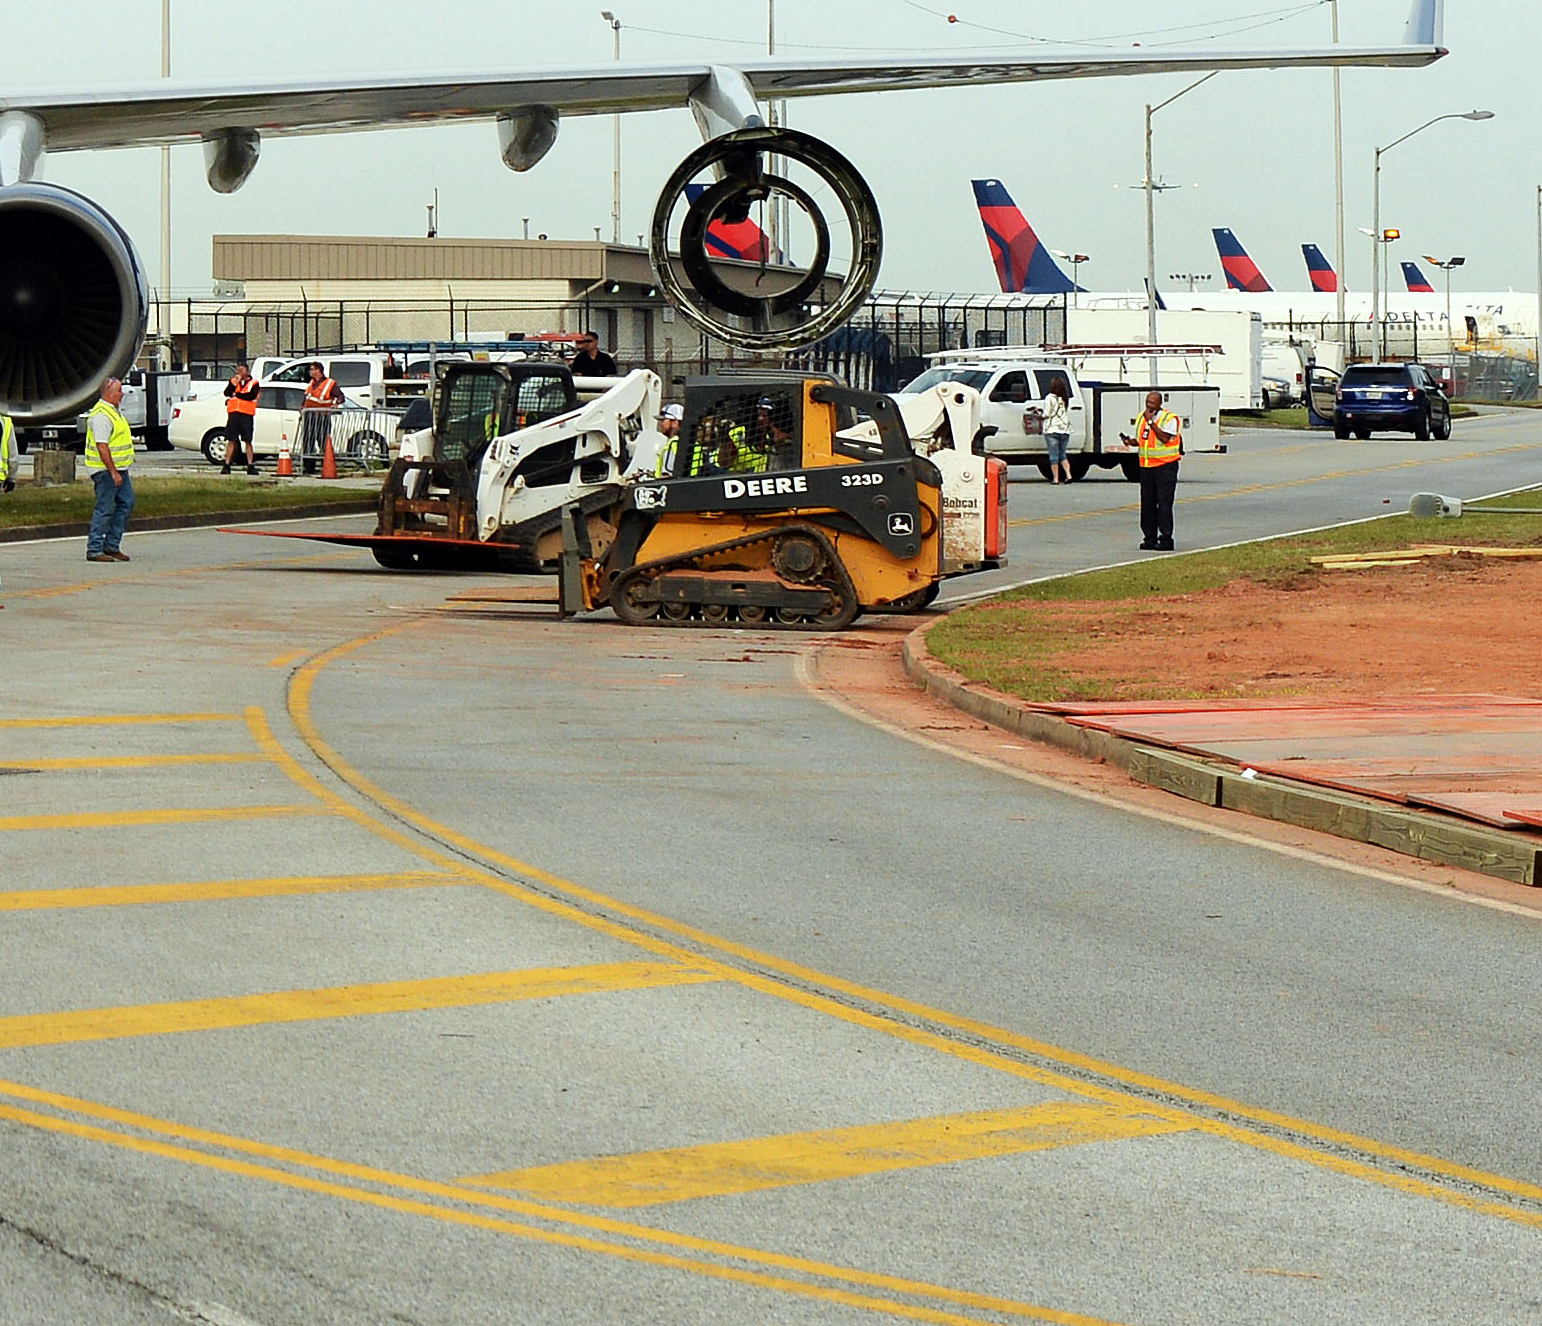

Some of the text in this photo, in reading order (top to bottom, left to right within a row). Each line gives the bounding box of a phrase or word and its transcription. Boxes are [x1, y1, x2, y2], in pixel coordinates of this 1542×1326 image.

[723, 475, 808, 499] DEERE
[841, 474, 884, 487] 323D
[943, 497, 978, 509] Bobcat
